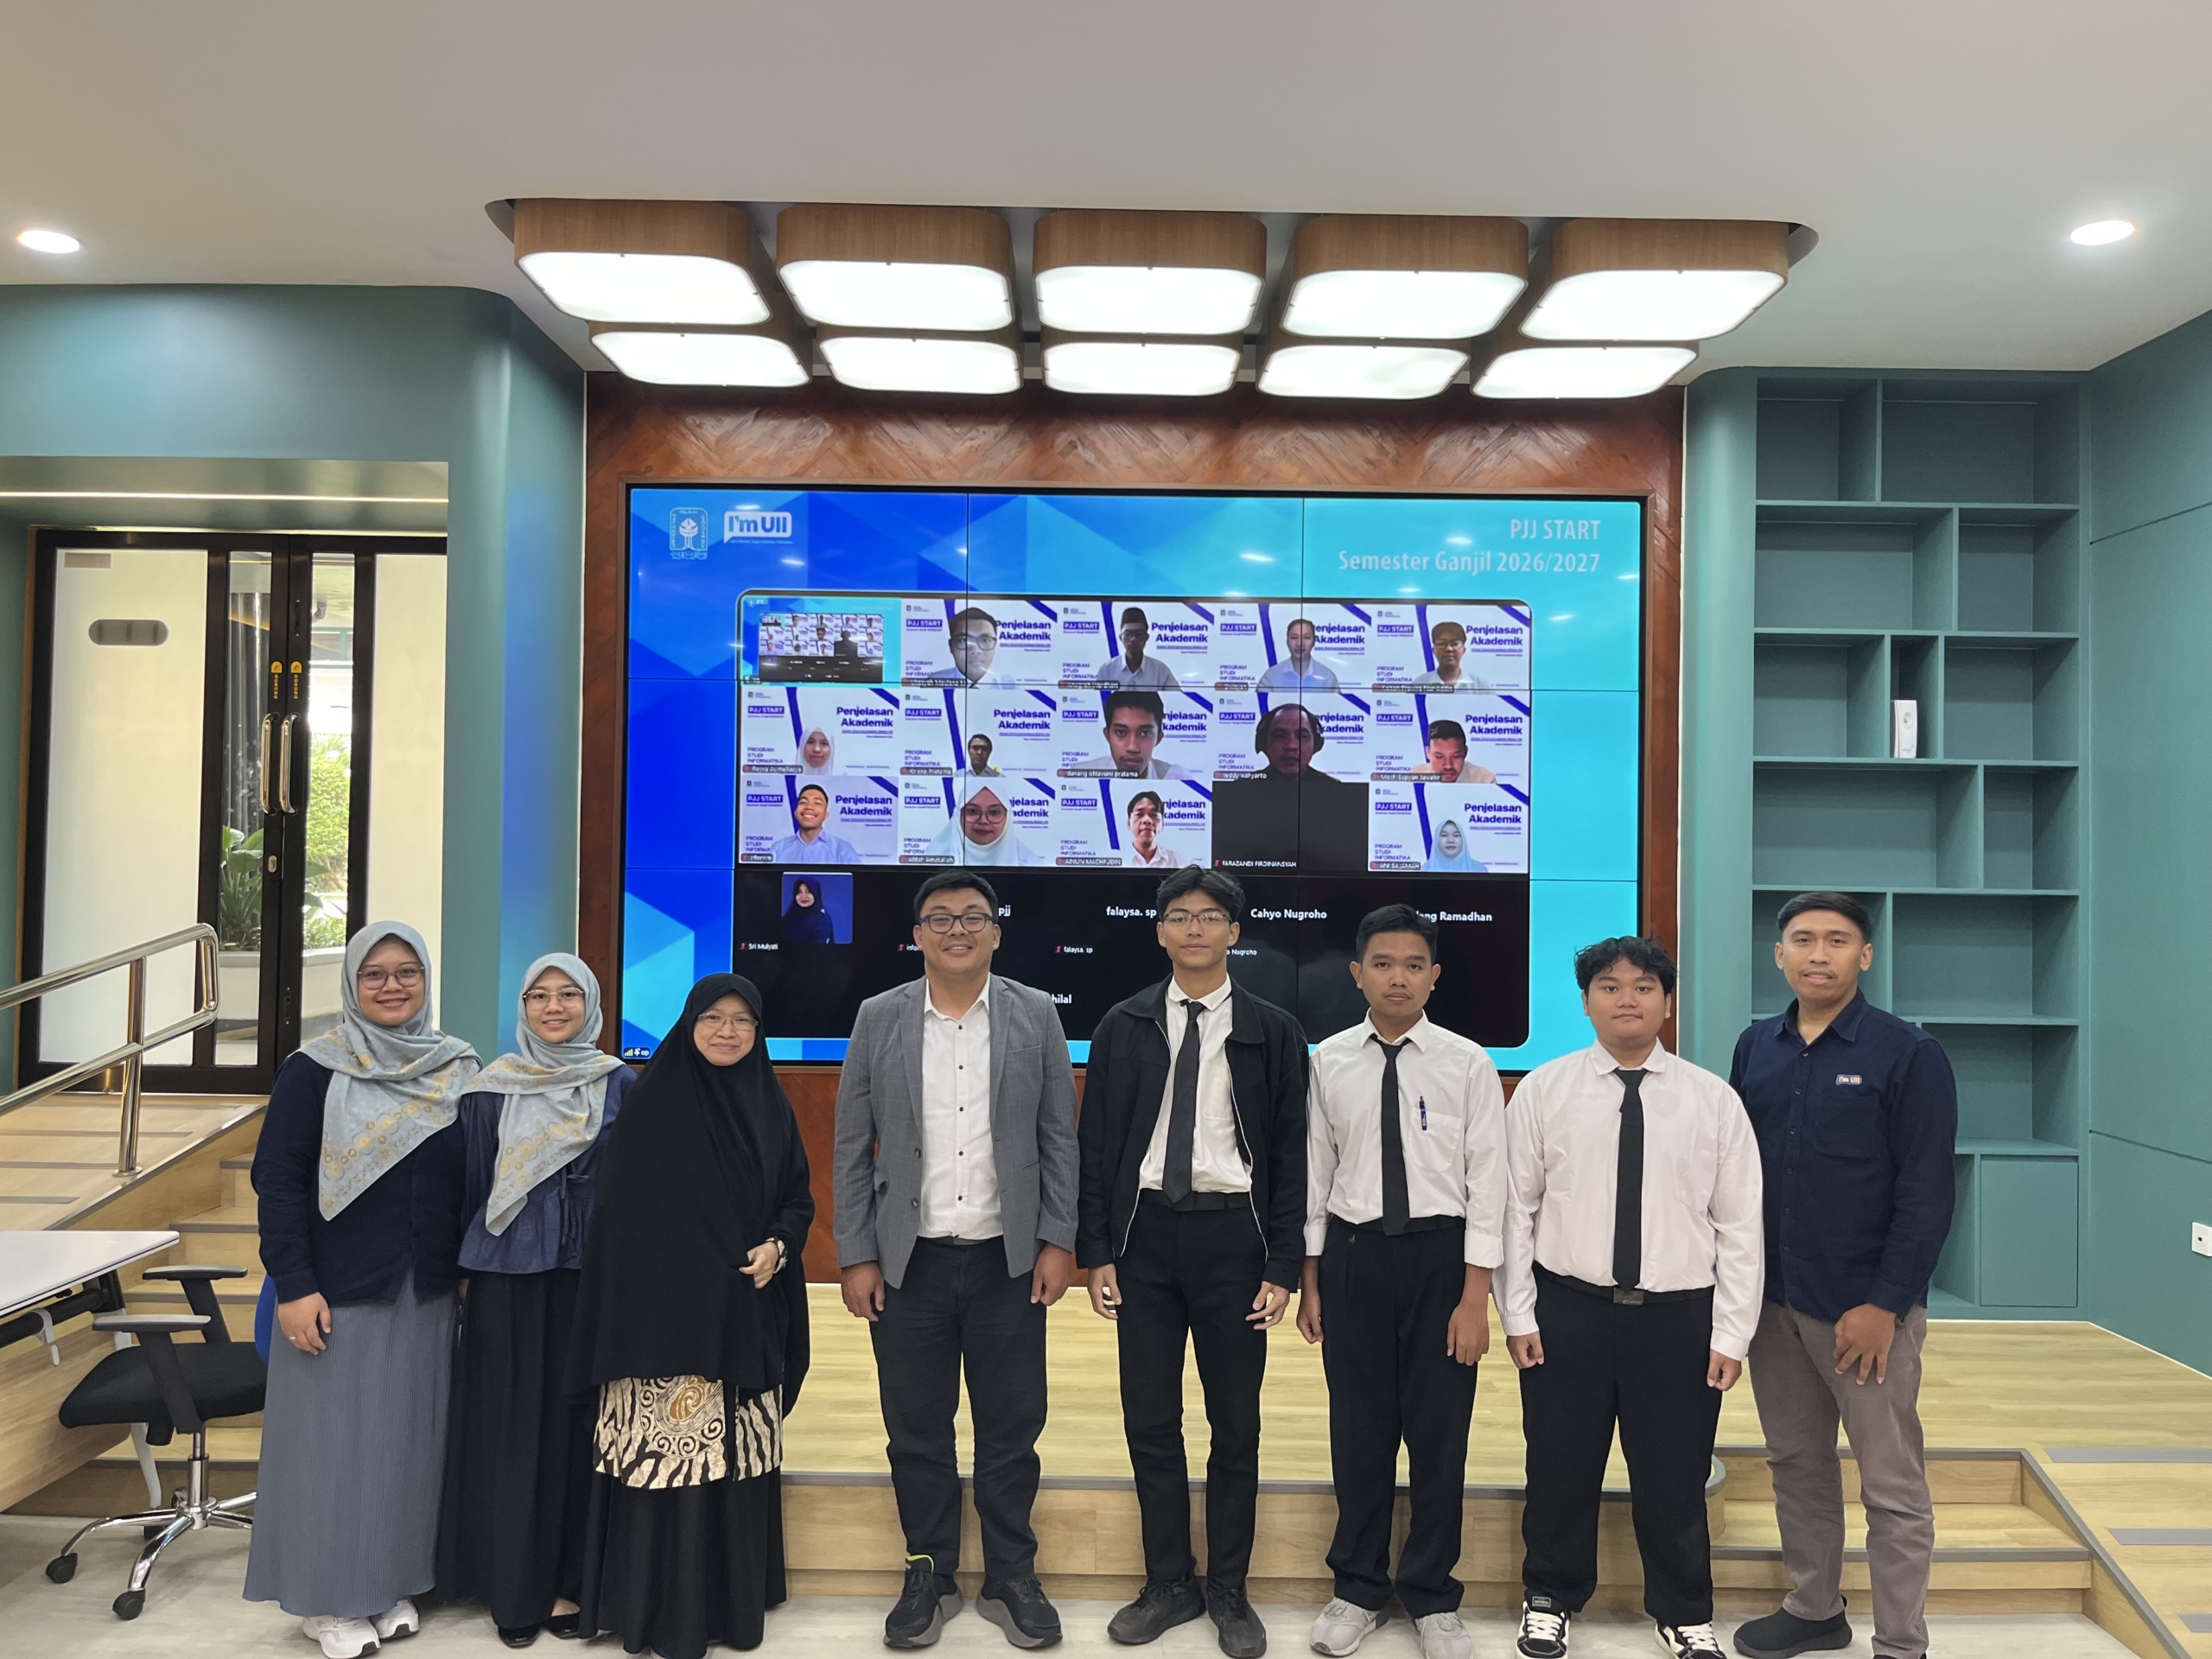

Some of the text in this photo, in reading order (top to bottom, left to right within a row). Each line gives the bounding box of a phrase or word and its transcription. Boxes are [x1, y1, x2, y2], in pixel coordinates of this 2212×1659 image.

[729, 516, 787, 533] I'm UII
[1510, 519, 1601, 540] PJJ START
[1339, 550, 1600, 577] Semester Ganjil 2026/2027
[1152, 623, 1208, 632] Penjelasan
[1315, 624, 1365, 634] enjelasan
[1466, 626, 1522, 636] Penjelasan
[999, 632, 1051, 640] Akademik
[1156, 634, 1208, 643] Akademik
[1470, 637, 1522, 646] Akademik
[836, 707, 893, 717] Penjelasan
[993, 710, 1050, 720] Penjelasan
[1164, 711, 1207, 721] njelasan
[841, 718, 892, 727] Akademik
[1316, 713, 1364, 723] enjelasan
[1465, 715, 1521, 725] Penjelasan
[998, 721, 1050, 730] Akademik
[1163, 723, 1207, 731] kademik
[1469, 727, 1521, 735] Akademik
[835, 795, 891, 805] Penjelasan
[1009, 798, 1049, 807] jelasan
[1163, 799, 1206, 809] njelasan
[839, 807, 891, 815] Akademik
[1464, 803, 1520, 813] Penjelasan
[1013, 809, 1049, 818] ademik
[1468, 815, 1520, 823] Akademik
[999, 905, 1011, 917] pjj
[1106, 906, 1157, 918] falaysa. sp
[1251, 908, 1327, 921] Cahyo Nugroho
[1440, 912, 1492, 921] Ramadhan
